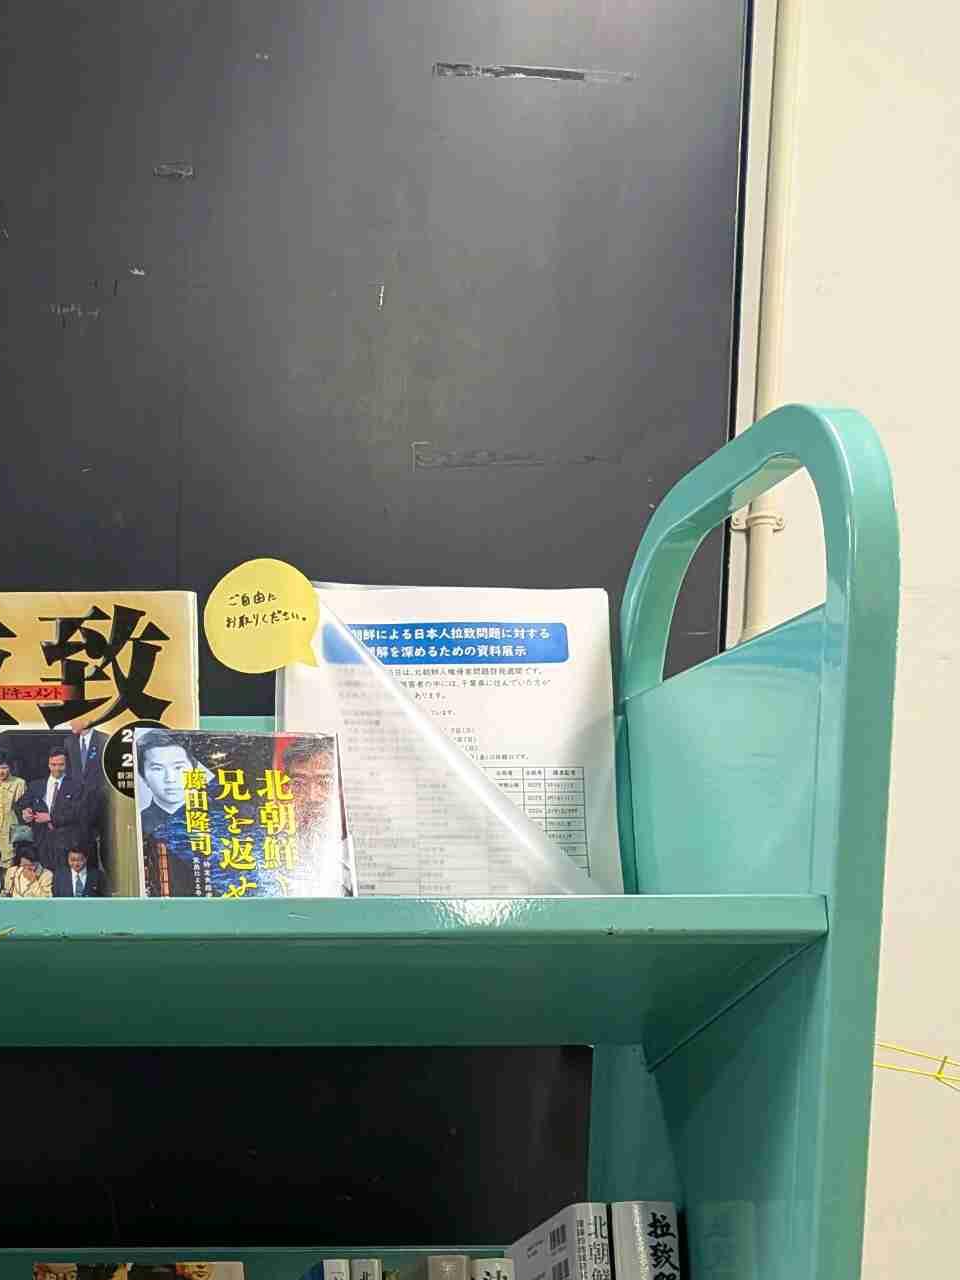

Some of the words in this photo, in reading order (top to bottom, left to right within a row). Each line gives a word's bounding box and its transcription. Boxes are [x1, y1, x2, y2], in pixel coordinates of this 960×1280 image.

[227, 590, 278, 607] ご自由に
[350, 627, 551, 642] 朝鮮による日本人拉致問題に対する
[0, 686, 64, 700] ドキュメント
[183, 767, 213, 856] 藤田隆司
